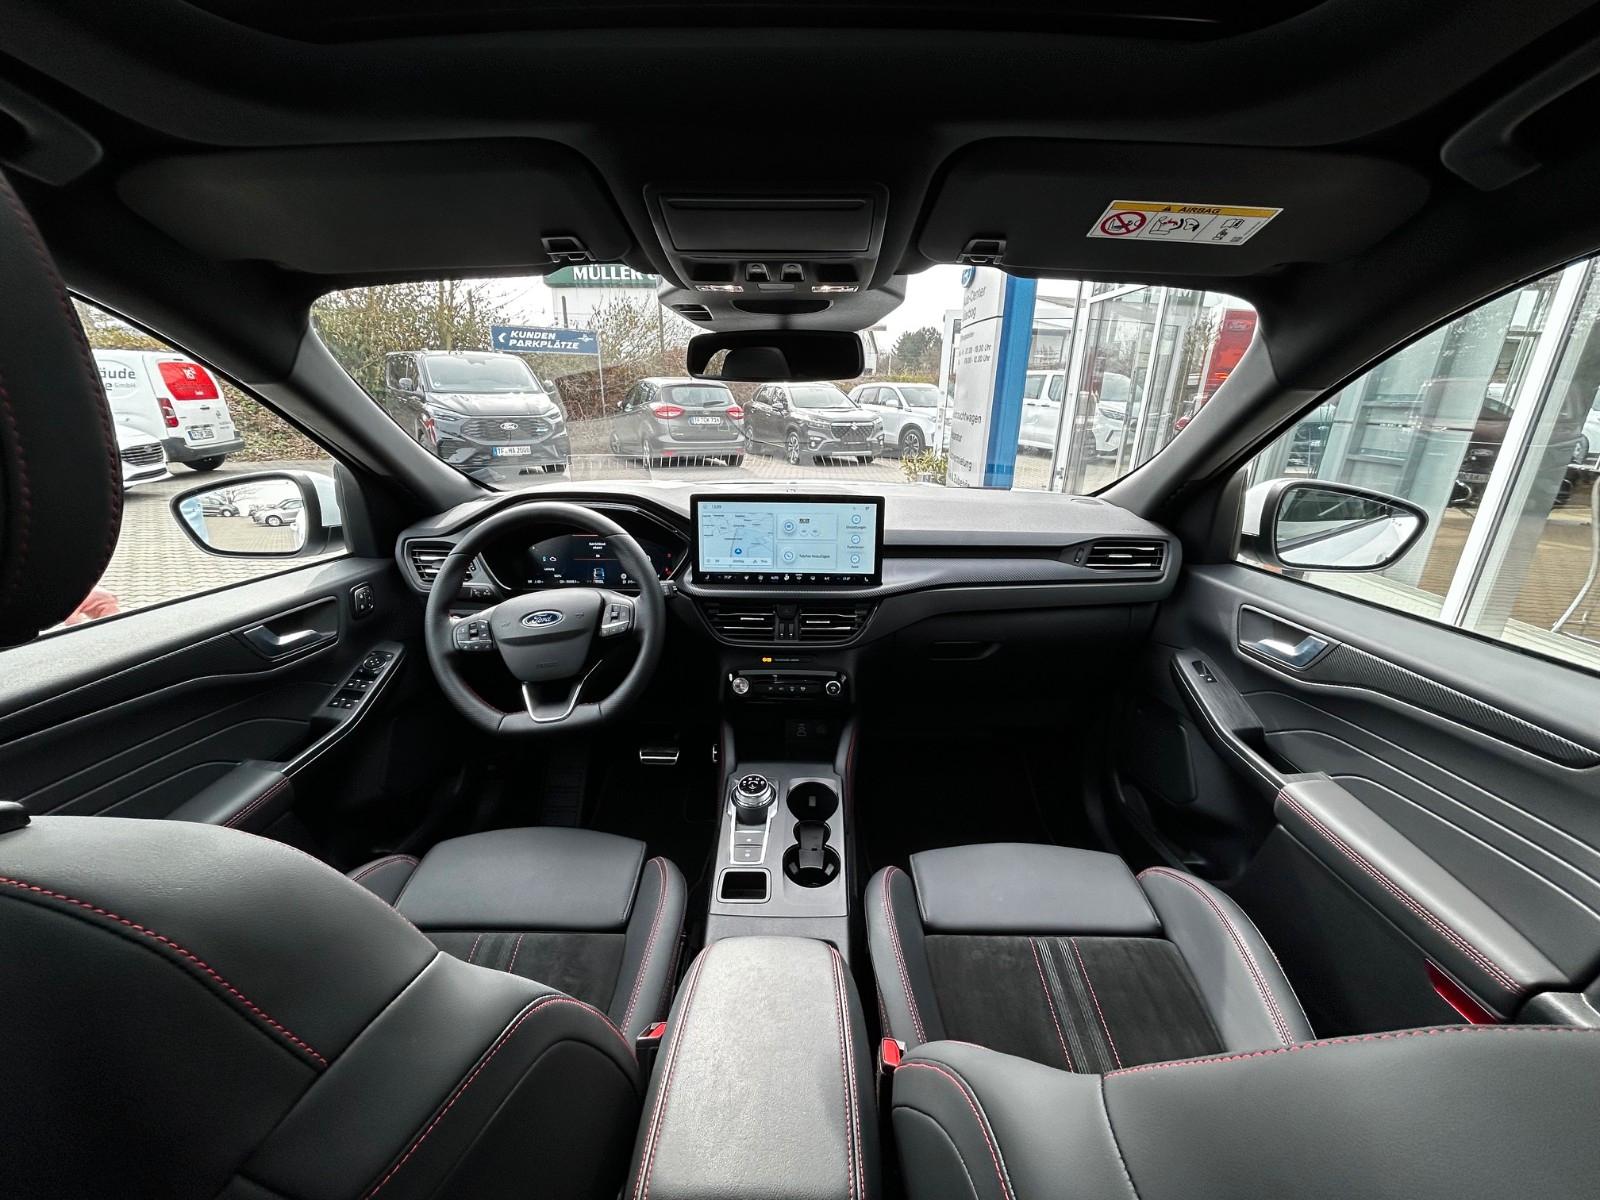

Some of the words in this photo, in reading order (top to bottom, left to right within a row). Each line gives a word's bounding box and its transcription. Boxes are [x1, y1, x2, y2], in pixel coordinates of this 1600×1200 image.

[1178, 206, 1222, 215] AIRBAG
[573, 264, 643, 280] MÜLLER
[510, 330, 556, 340] KUNDEN
[508, 339, 580, 350] PARKPLÄTZE
